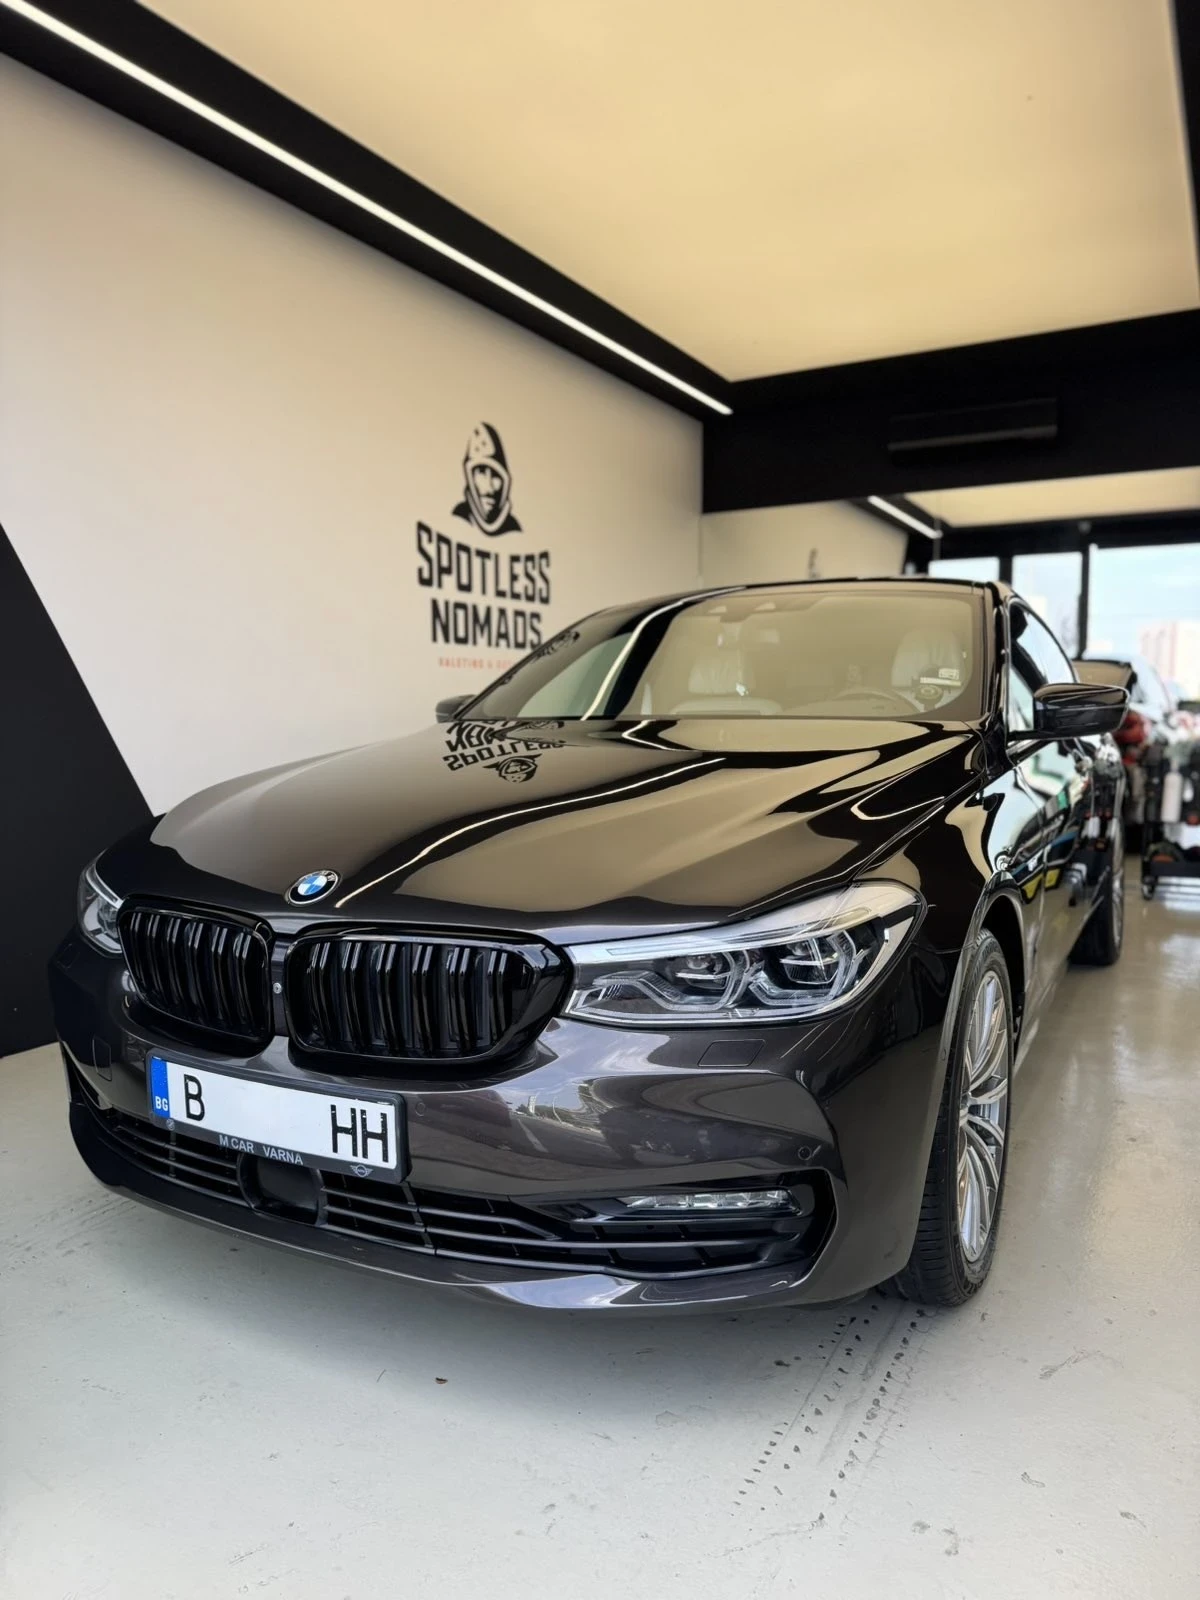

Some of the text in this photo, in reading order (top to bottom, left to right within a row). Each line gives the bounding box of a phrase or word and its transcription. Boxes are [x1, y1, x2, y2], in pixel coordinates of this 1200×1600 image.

[416, 520, 550, 605] SPOTLESS
[431, 598, 541, 650] NOMADS
[155, 1096, 168, 1111] BG
[183, 1073, 389, 1163] B HH
[219, 1135, 303, 1165] M CAR VARNA
